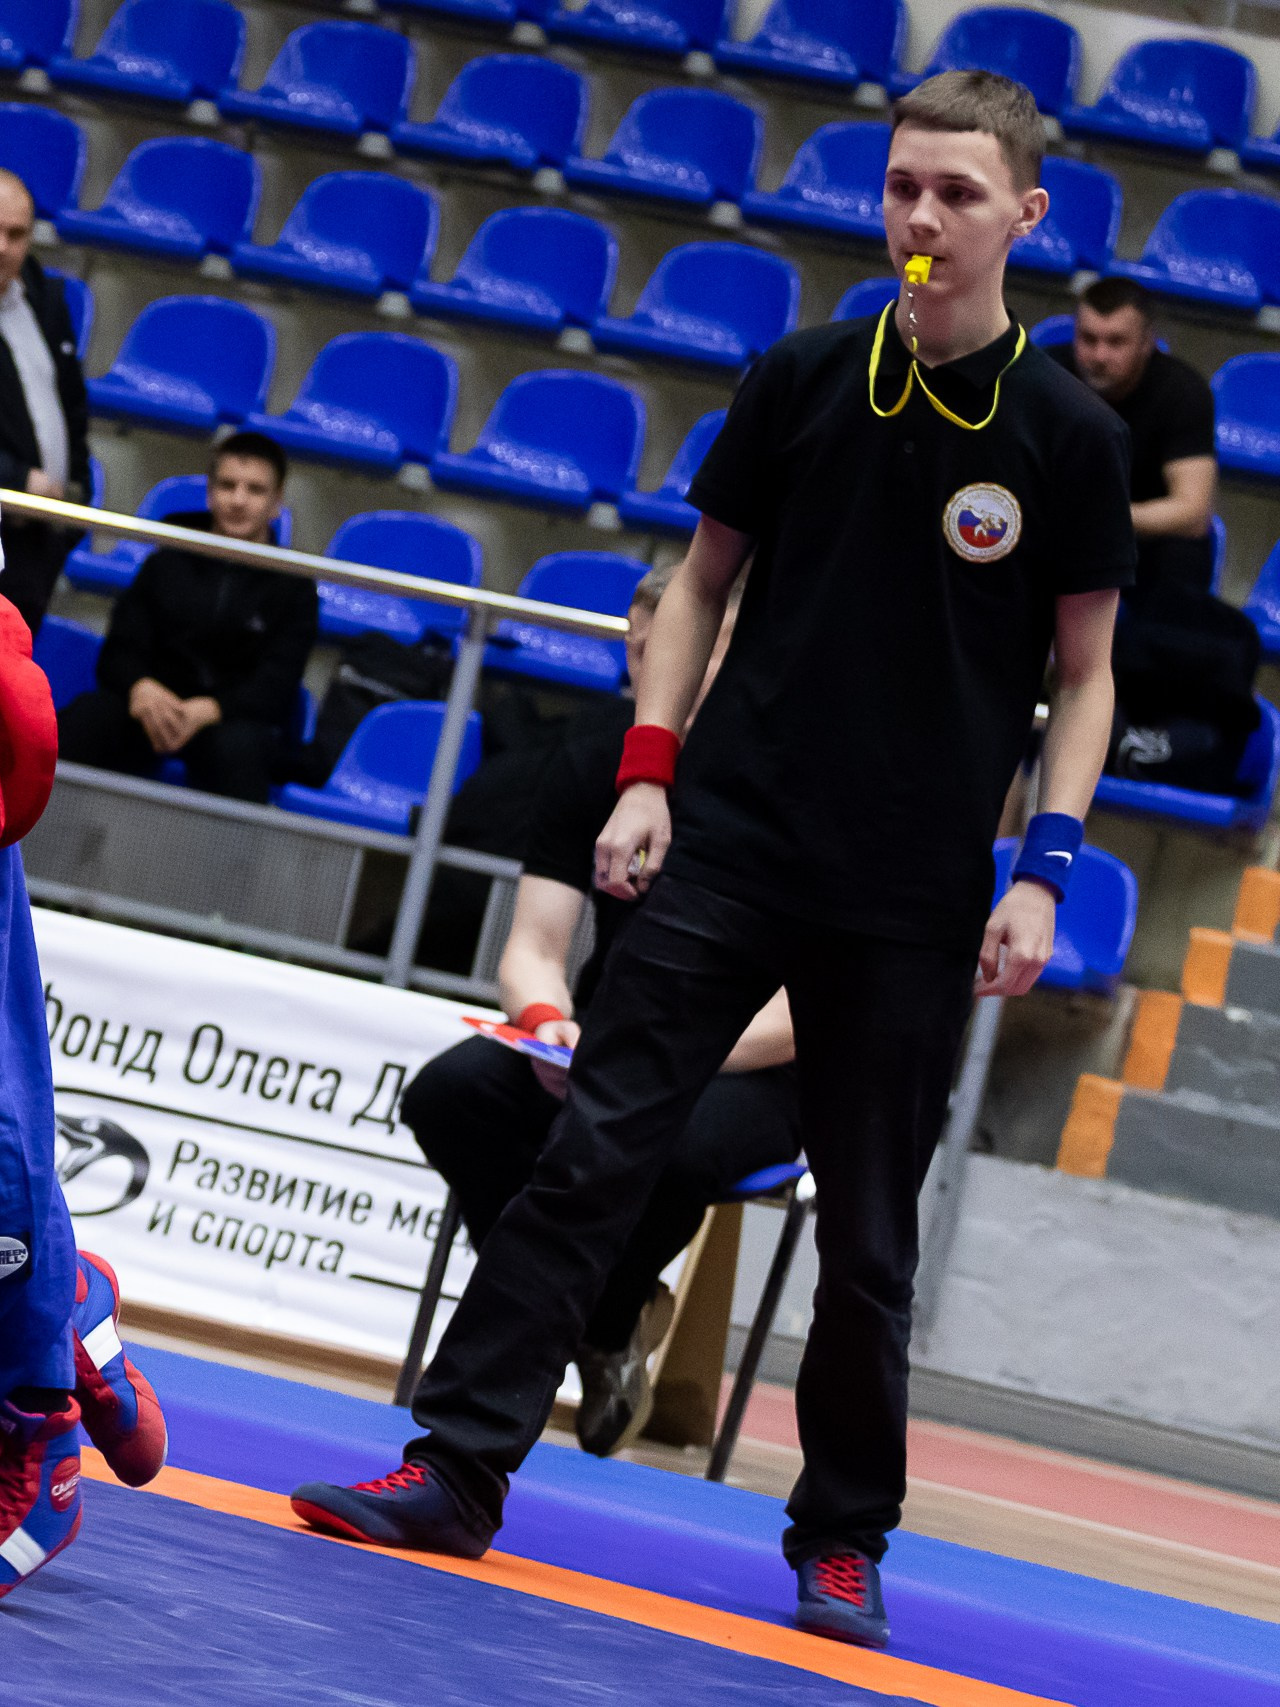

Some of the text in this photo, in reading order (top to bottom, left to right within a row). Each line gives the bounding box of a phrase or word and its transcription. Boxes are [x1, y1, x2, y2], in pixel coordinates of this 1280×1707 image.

[182, 1022, 343, 1114] Олега
[166, 1139, 374, 1225] Развитие
[146, 1200, 345, 1274] и спорта
